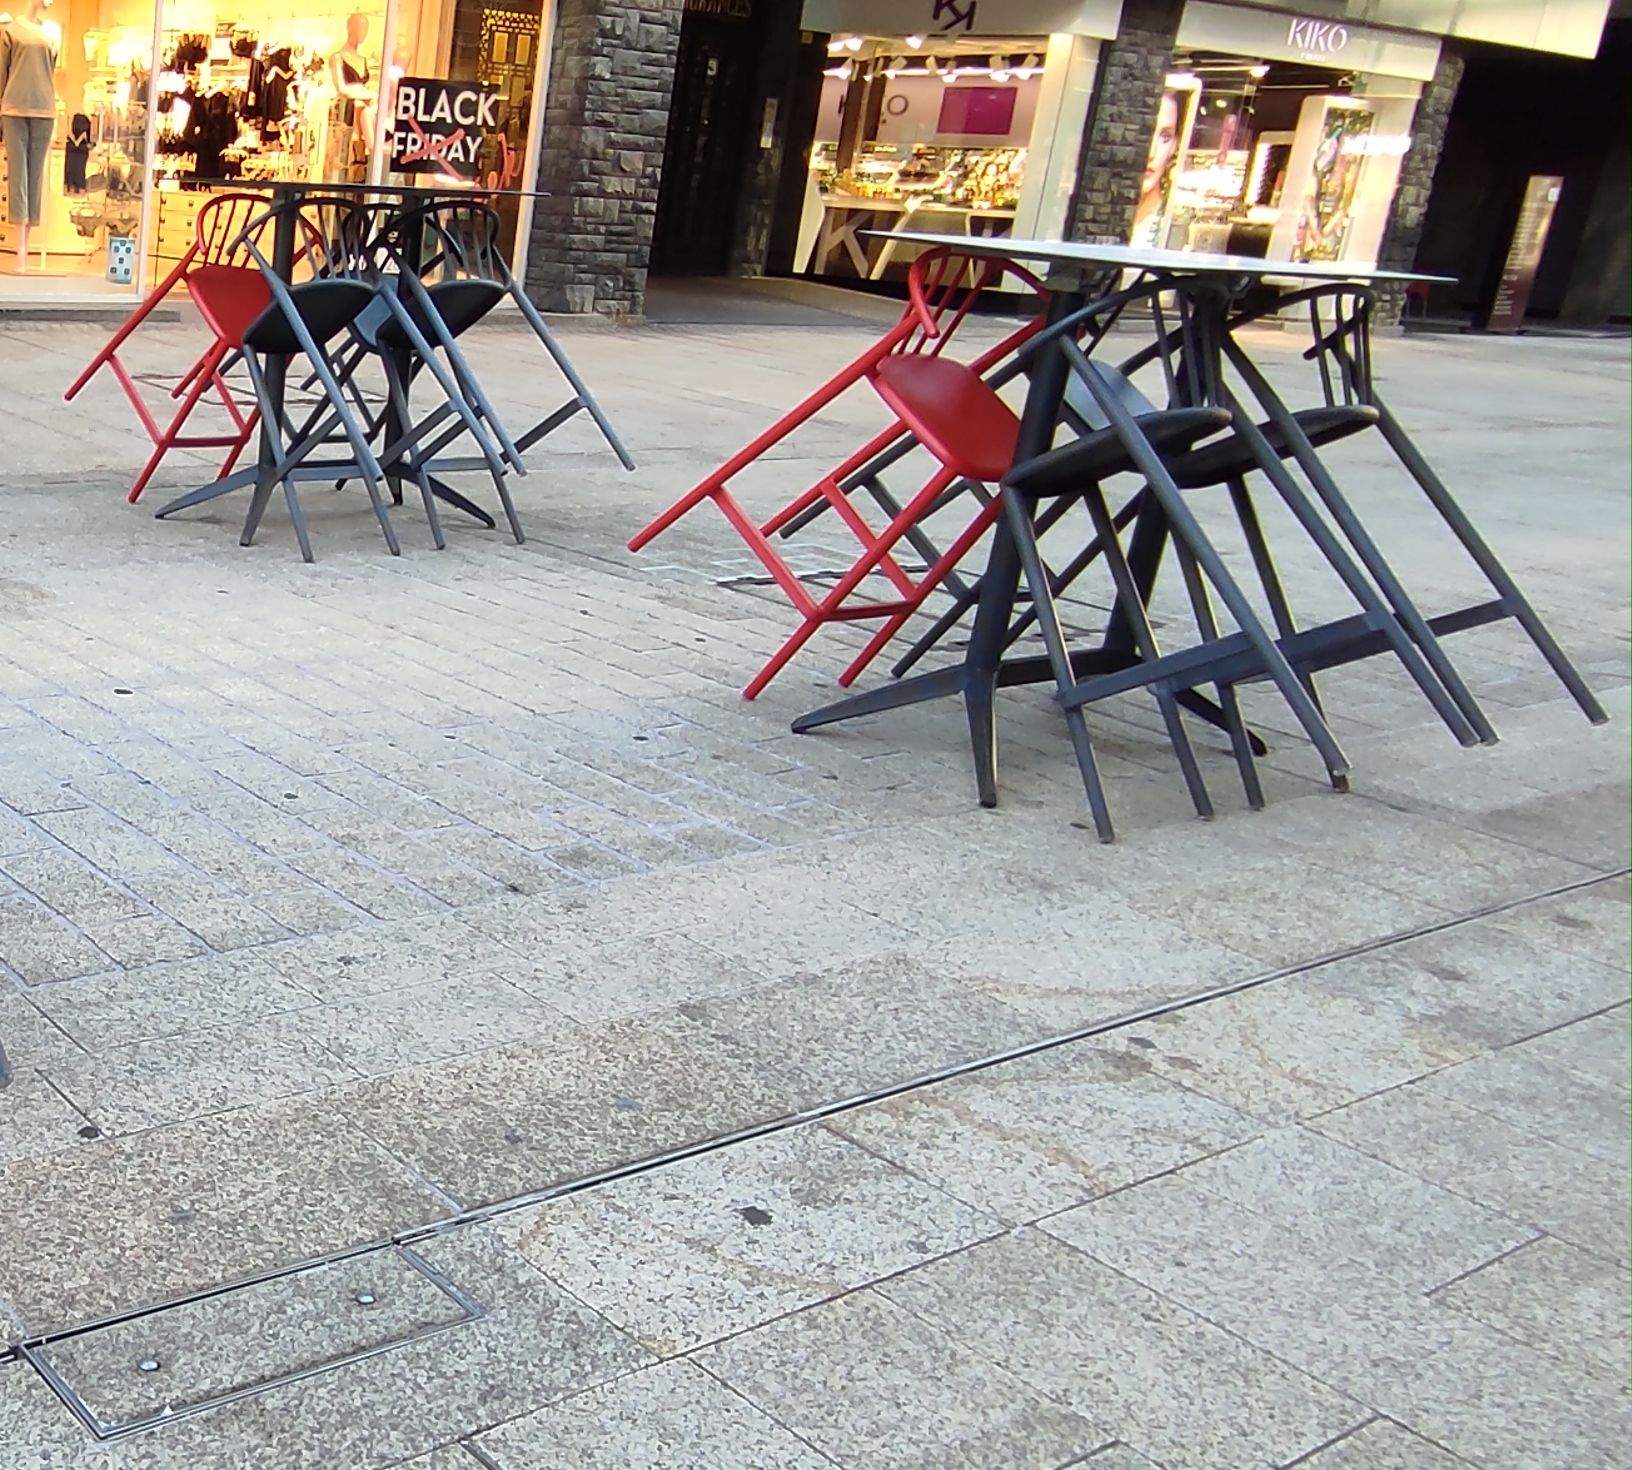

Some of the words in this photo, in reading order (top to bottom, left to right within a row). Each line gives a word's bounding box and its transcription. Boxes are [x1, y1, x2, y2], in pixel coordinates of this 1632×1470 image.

[1287, 18, 1348, 52] KIKO
[396, 86, 498, 127] BLACK
[392, 131, 483, 163] FRIDAY
